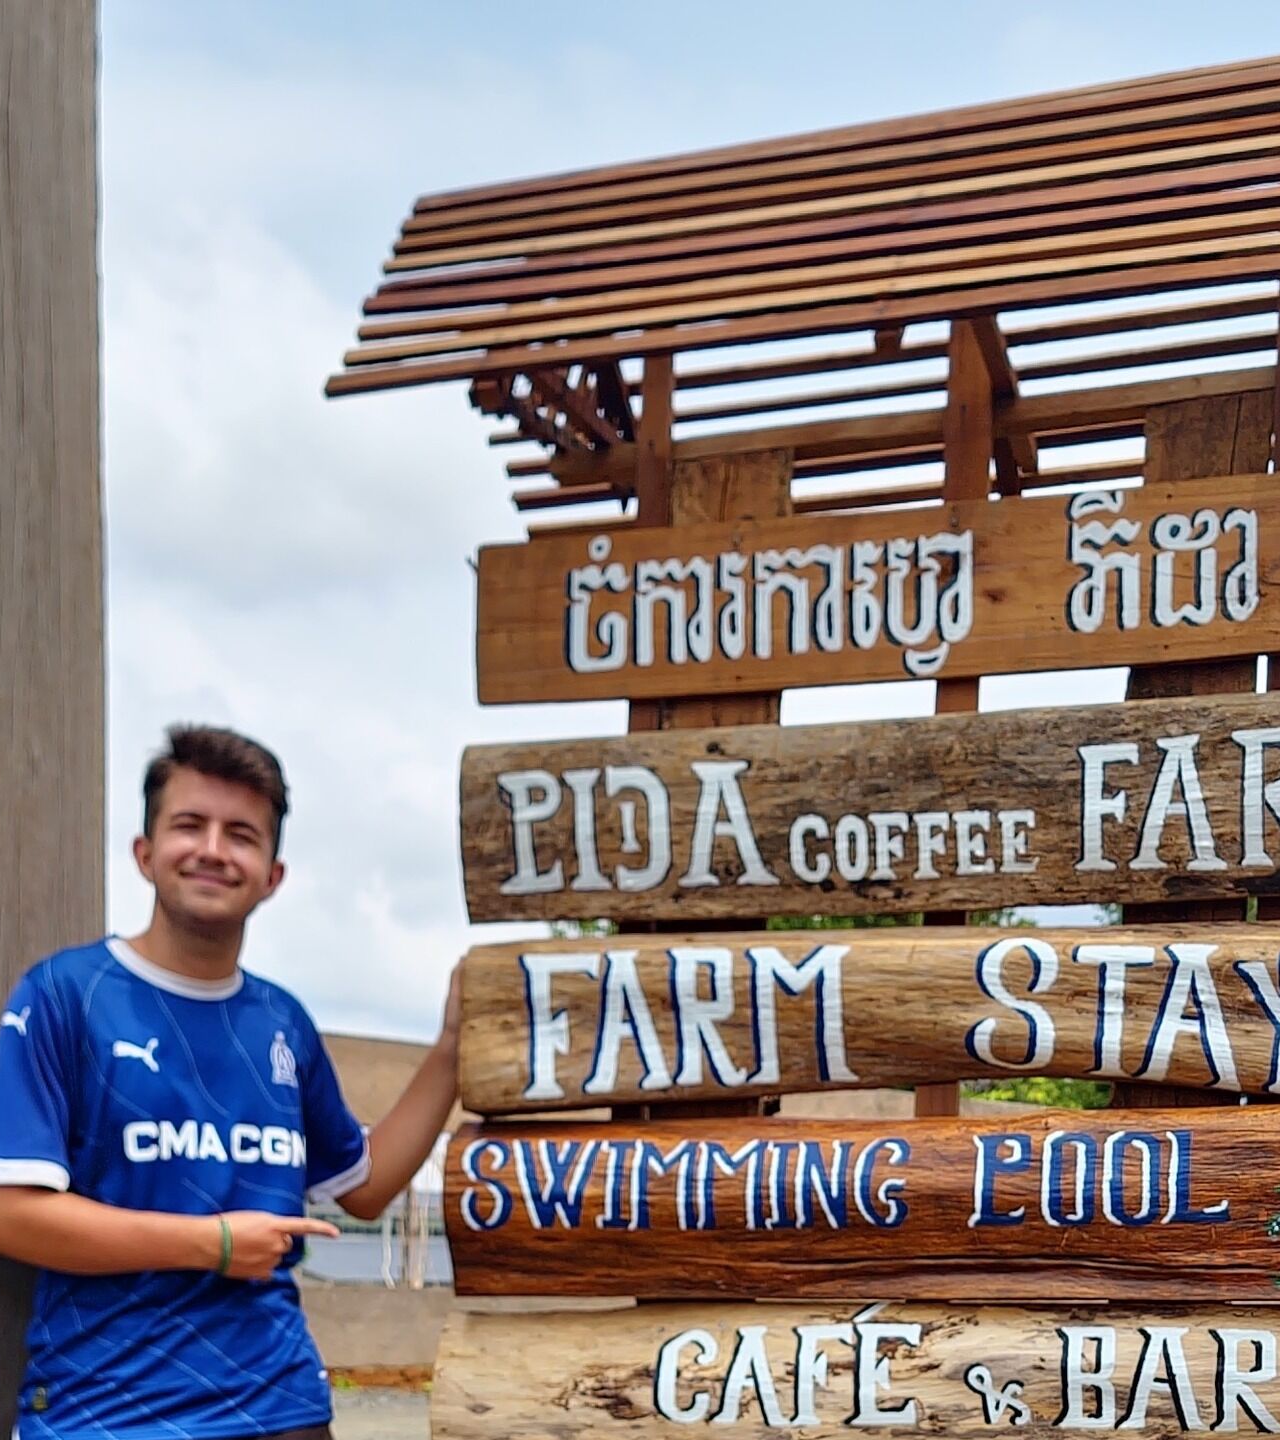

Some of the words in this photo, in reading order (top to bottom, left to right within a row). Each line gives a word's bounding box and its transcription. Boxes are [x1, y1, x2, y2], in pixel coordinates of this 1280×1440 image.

[497, 760, 781, 896] PIDA
[789, 808, 1038, 884] COFFEE
[520, 945, 860, 1101] FARM
[123, 1119, 228, 1163] CMA
[459, 1135, 911, 1232] SWIMMING
[968, 1130, 1230, 1229] POOL
[653, 1302, 923, 1428] CAFÉ
[962, 1363, 1031, 1427] &
